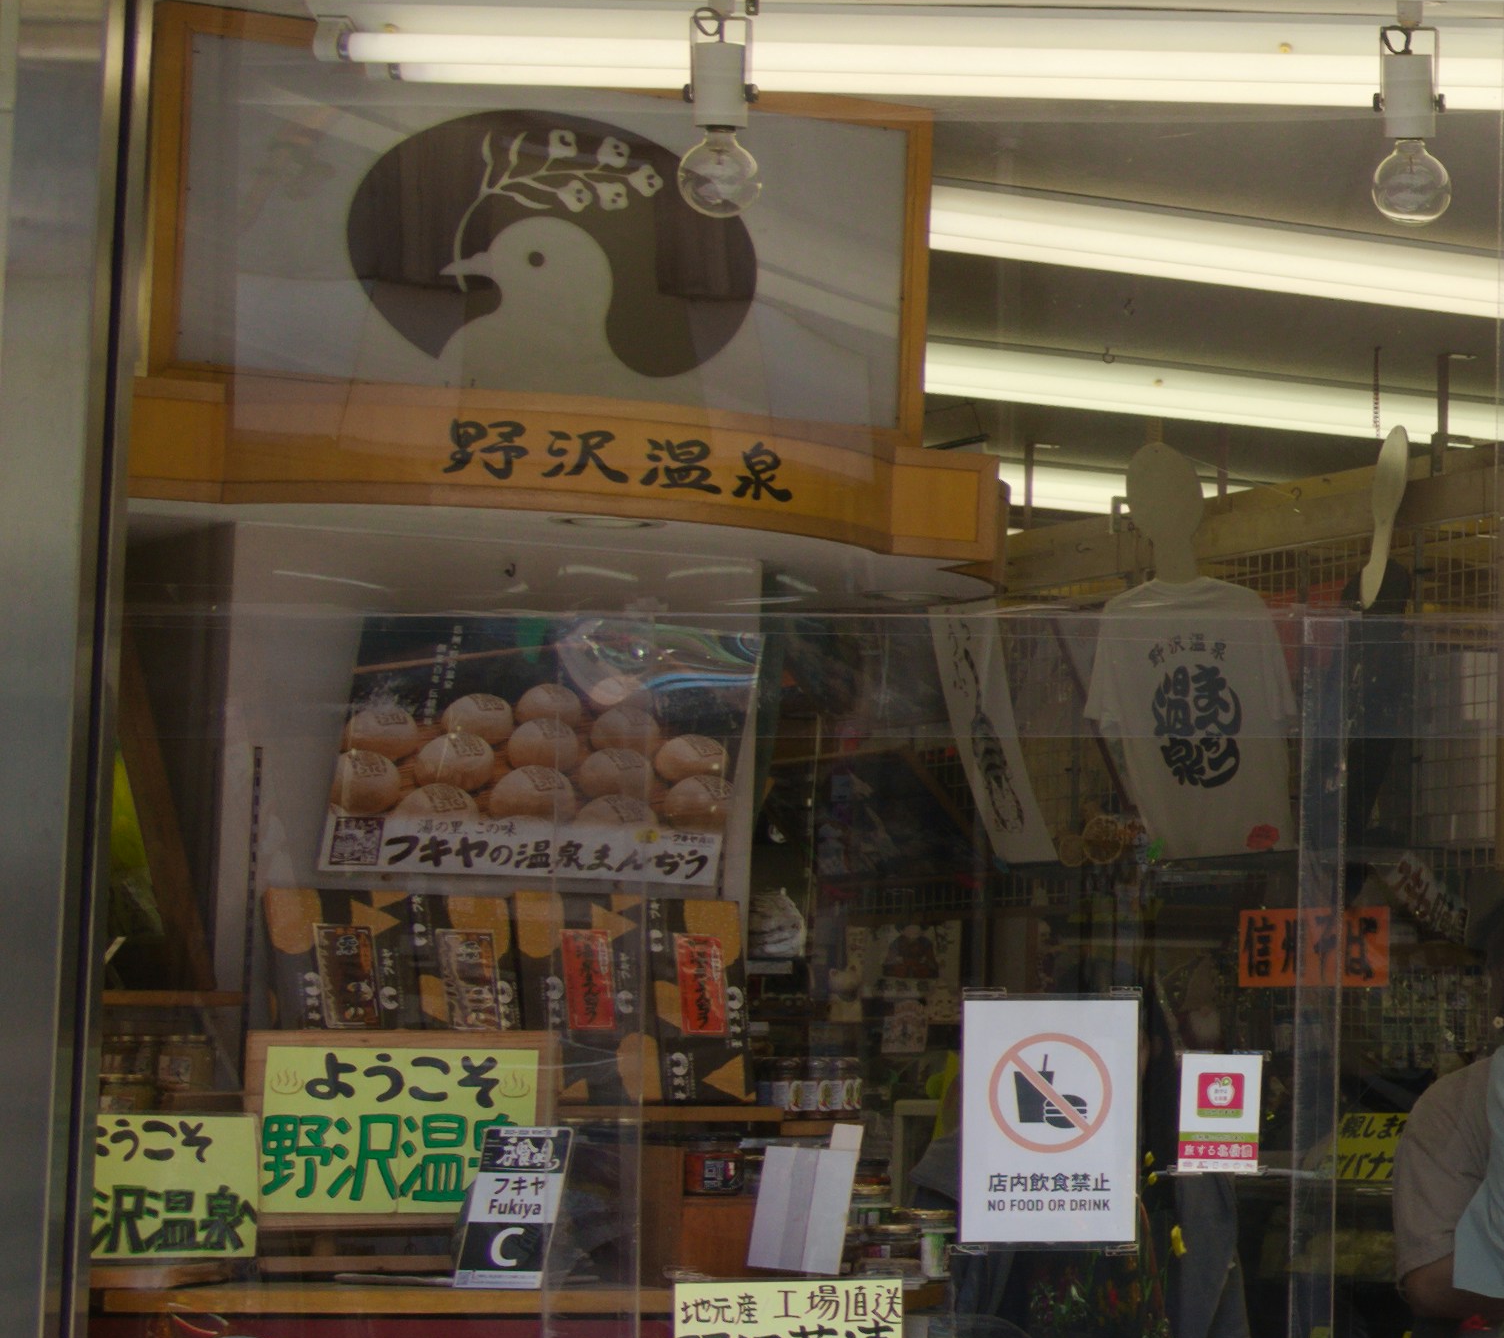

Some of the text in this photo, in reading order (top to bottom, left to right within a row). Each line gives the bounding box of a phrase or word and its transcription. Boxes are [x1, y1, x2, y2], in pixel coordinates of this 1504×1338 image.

[442, 417, 793, 502] 野沢温泉
[384, 834, 709, 880] フキヤの温泉まんぢう
[306, 1052, 501, 1109] ようこそ
[494, 1177, 545, 1196] フキヤ
[988, 1173, 1111, 1193] 店内飲食禁止
[488, 1199, 541, 1219] Fukiya
[988, 1199, 1111, 1212] NO FOOD OR DRINK
[490, 1226, 525, 1267] C
[681, 1284, 904, 1326] 地元産 工場直送
